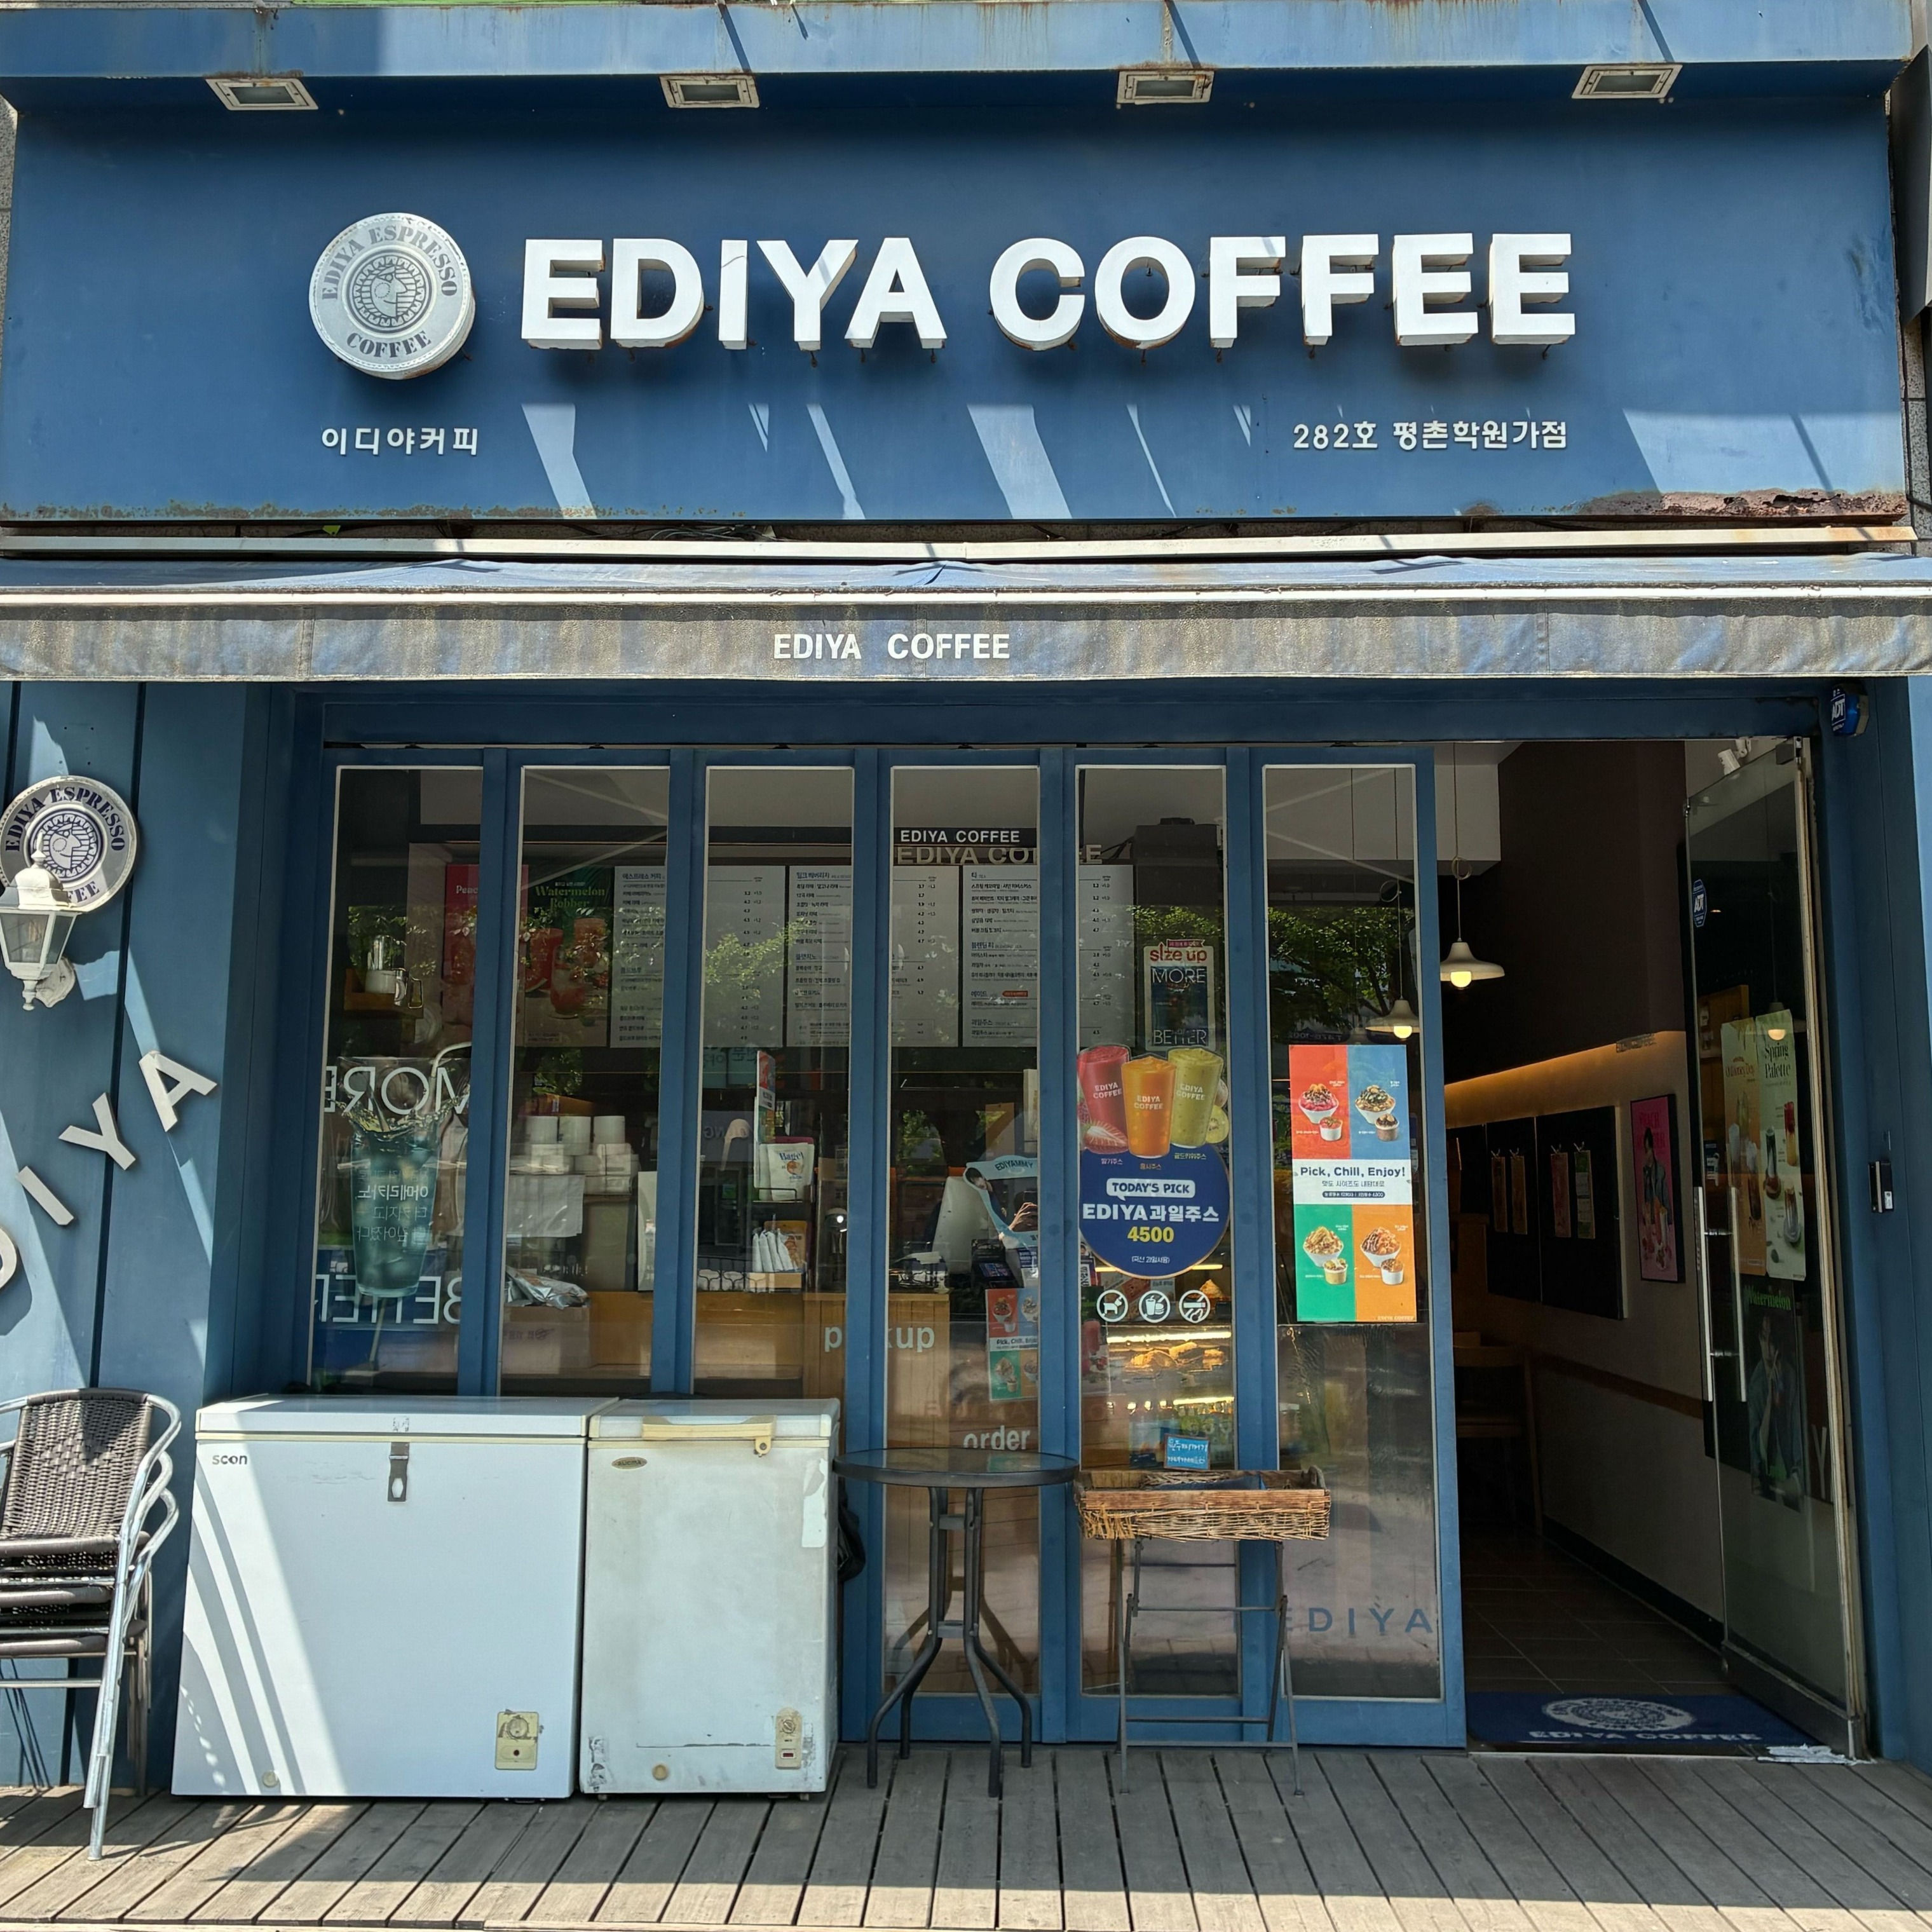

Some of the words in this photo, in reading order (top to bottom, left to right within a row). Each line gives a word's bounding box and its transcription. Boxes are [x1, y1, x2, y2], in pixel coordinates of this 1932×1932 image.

[322, 240, 365, 300] EDIYA
[369, 225, 457, 296] ESPRESSO
[521, 236, 947, 348] EDIYA
[989, 233, 1575, 350] COFFEE
[347, 330, 432, 358] COFFEE
[322, 428, 478, 455] 이디야커피
[1293, 421, 1378, 449] 282호
[1393, 420, 1567, 451] 평촌학원가점
[773, 634, 862, 659] EDIYA
[887, 633, 1010, 659] COFFEE
[6, 798, 45, 851] EDIYA
[50, 787, 125, 851] ESPRESSO
[901, 831, 948, 843] EDIYA
[956, 831, 1020, 843] COFFEE
[897, 847, 979, 864] EDIYA
[456, 885, 479, 894] Peac
[535, 885, 606, 897] Watermelon
[550, 897, 590, 908] Robber
[1186, 949, 1207, 963] up
[1152, 968, 1205, 983] MORE
[1765, 1042, 1789, 1062] Spring
[1765, 1063, 1791, 1078] Palette
[1093, 1088, 1122, 1098] COFFEE
[1095, 1082, 1119, 1091] EDIYA
[1180, 1084, 1203, 1092] EDIYA
[1176, 1091, 1205, 1100] COFFEE
[1300, 1167, 1330, 1177] Pick,
[1334, 1167, 1364, 1177] Chill,
[1368, 1167, 1405, 1177] Enjoy!
[1112, 1183, 1159, 1193] TODAY'S
[1164, 1183, 1190, 1194] PICK
[1127, 1227, 1174, 1242] 4500
[1745, 1285, 1792, 1310] Watermelon
[963, 1425, 1030, 1450] order
[1528, 1731, 1627, 1740] EDIYA
[1635, 1732, 1763, 1741] COFFEE
